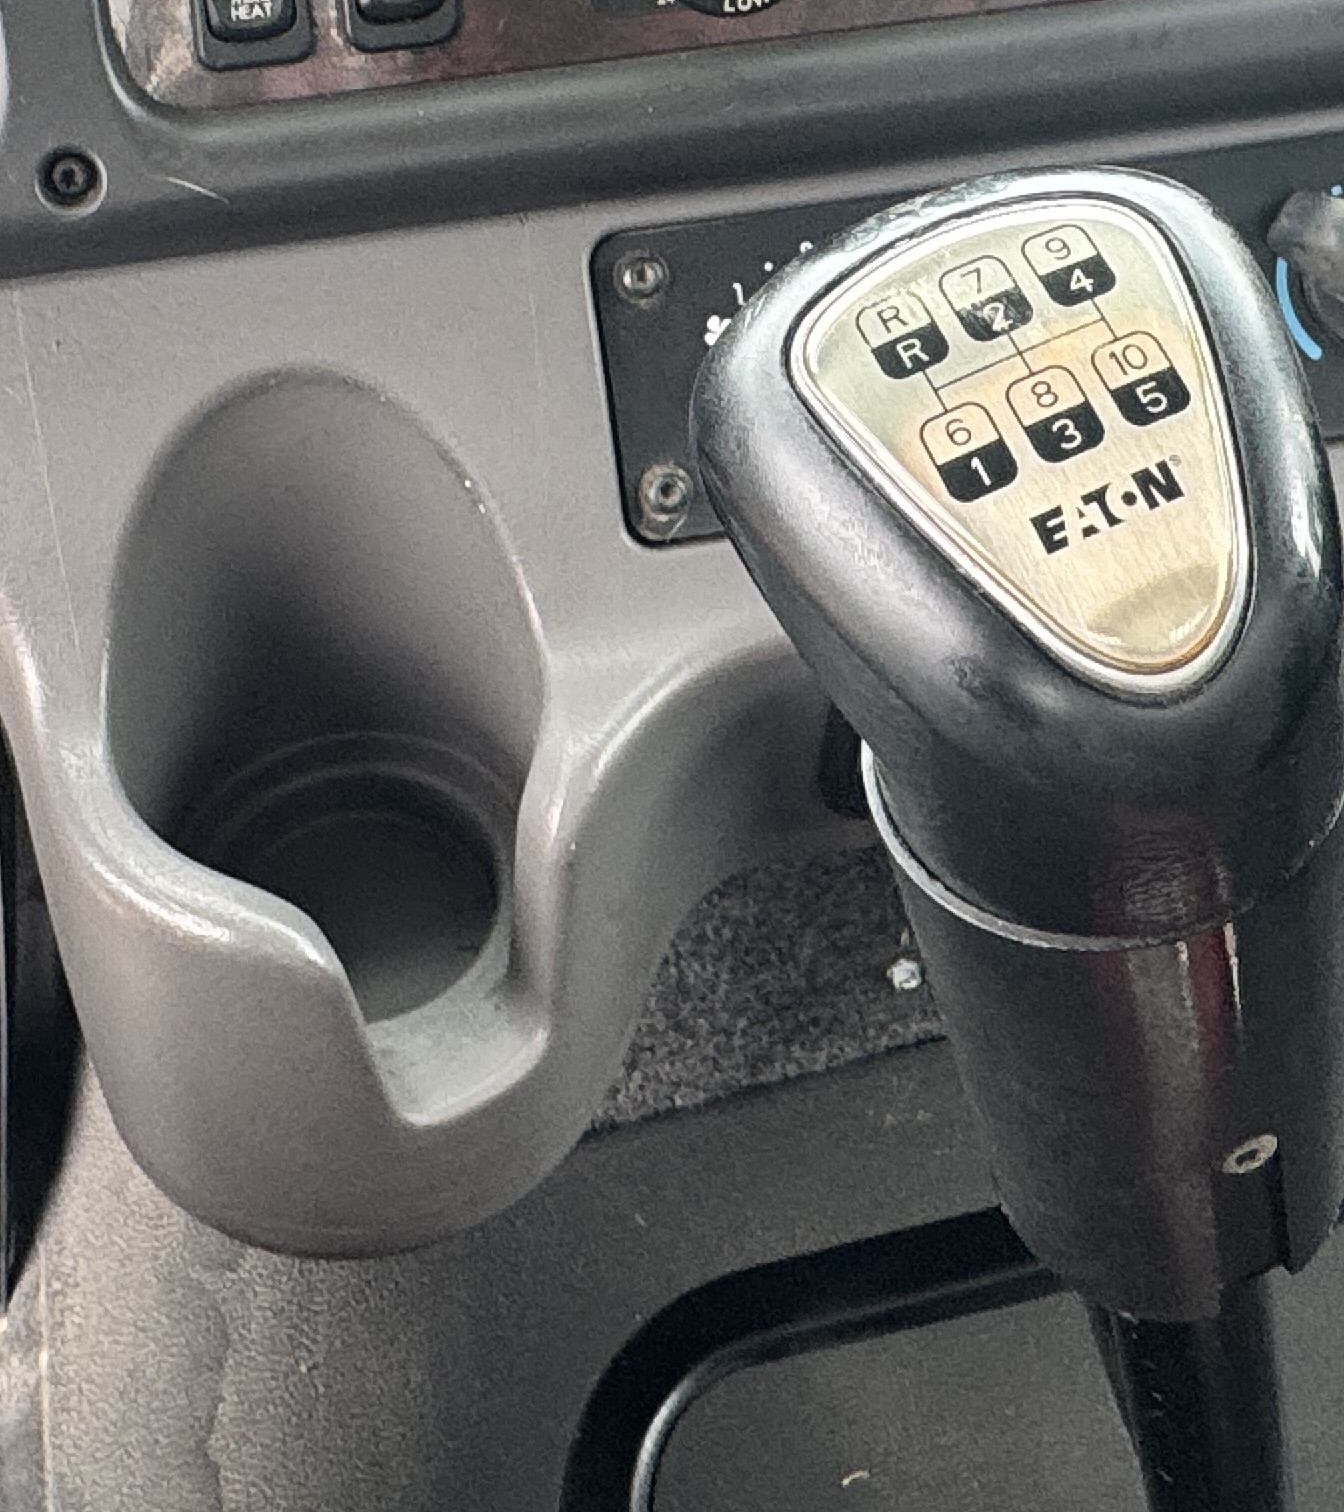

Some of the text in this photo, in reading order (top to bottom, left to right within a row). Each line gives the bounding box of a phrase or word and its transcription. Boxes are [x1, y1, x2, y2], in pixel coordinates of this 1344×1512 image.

[231, 1, 273, 22] HEAT
[1044, 237, 1071, 260] 9
[960, 267, 983, 294] 7
[1070, 268, 1094, 292] 4
[877, 305, 909, 334] R
[982, 301, 1013, 332] 2
[895, 338, 930, 370] R
[1108, 344, 1148, 376] 10
[1030, 380, 1059, 408] 8
[1134, 380, 1168, 414] 5
[945, 418, 972, 446] 6
[1052, 418, 1082, 450] 3
[969, 456, 992, 487] 1
